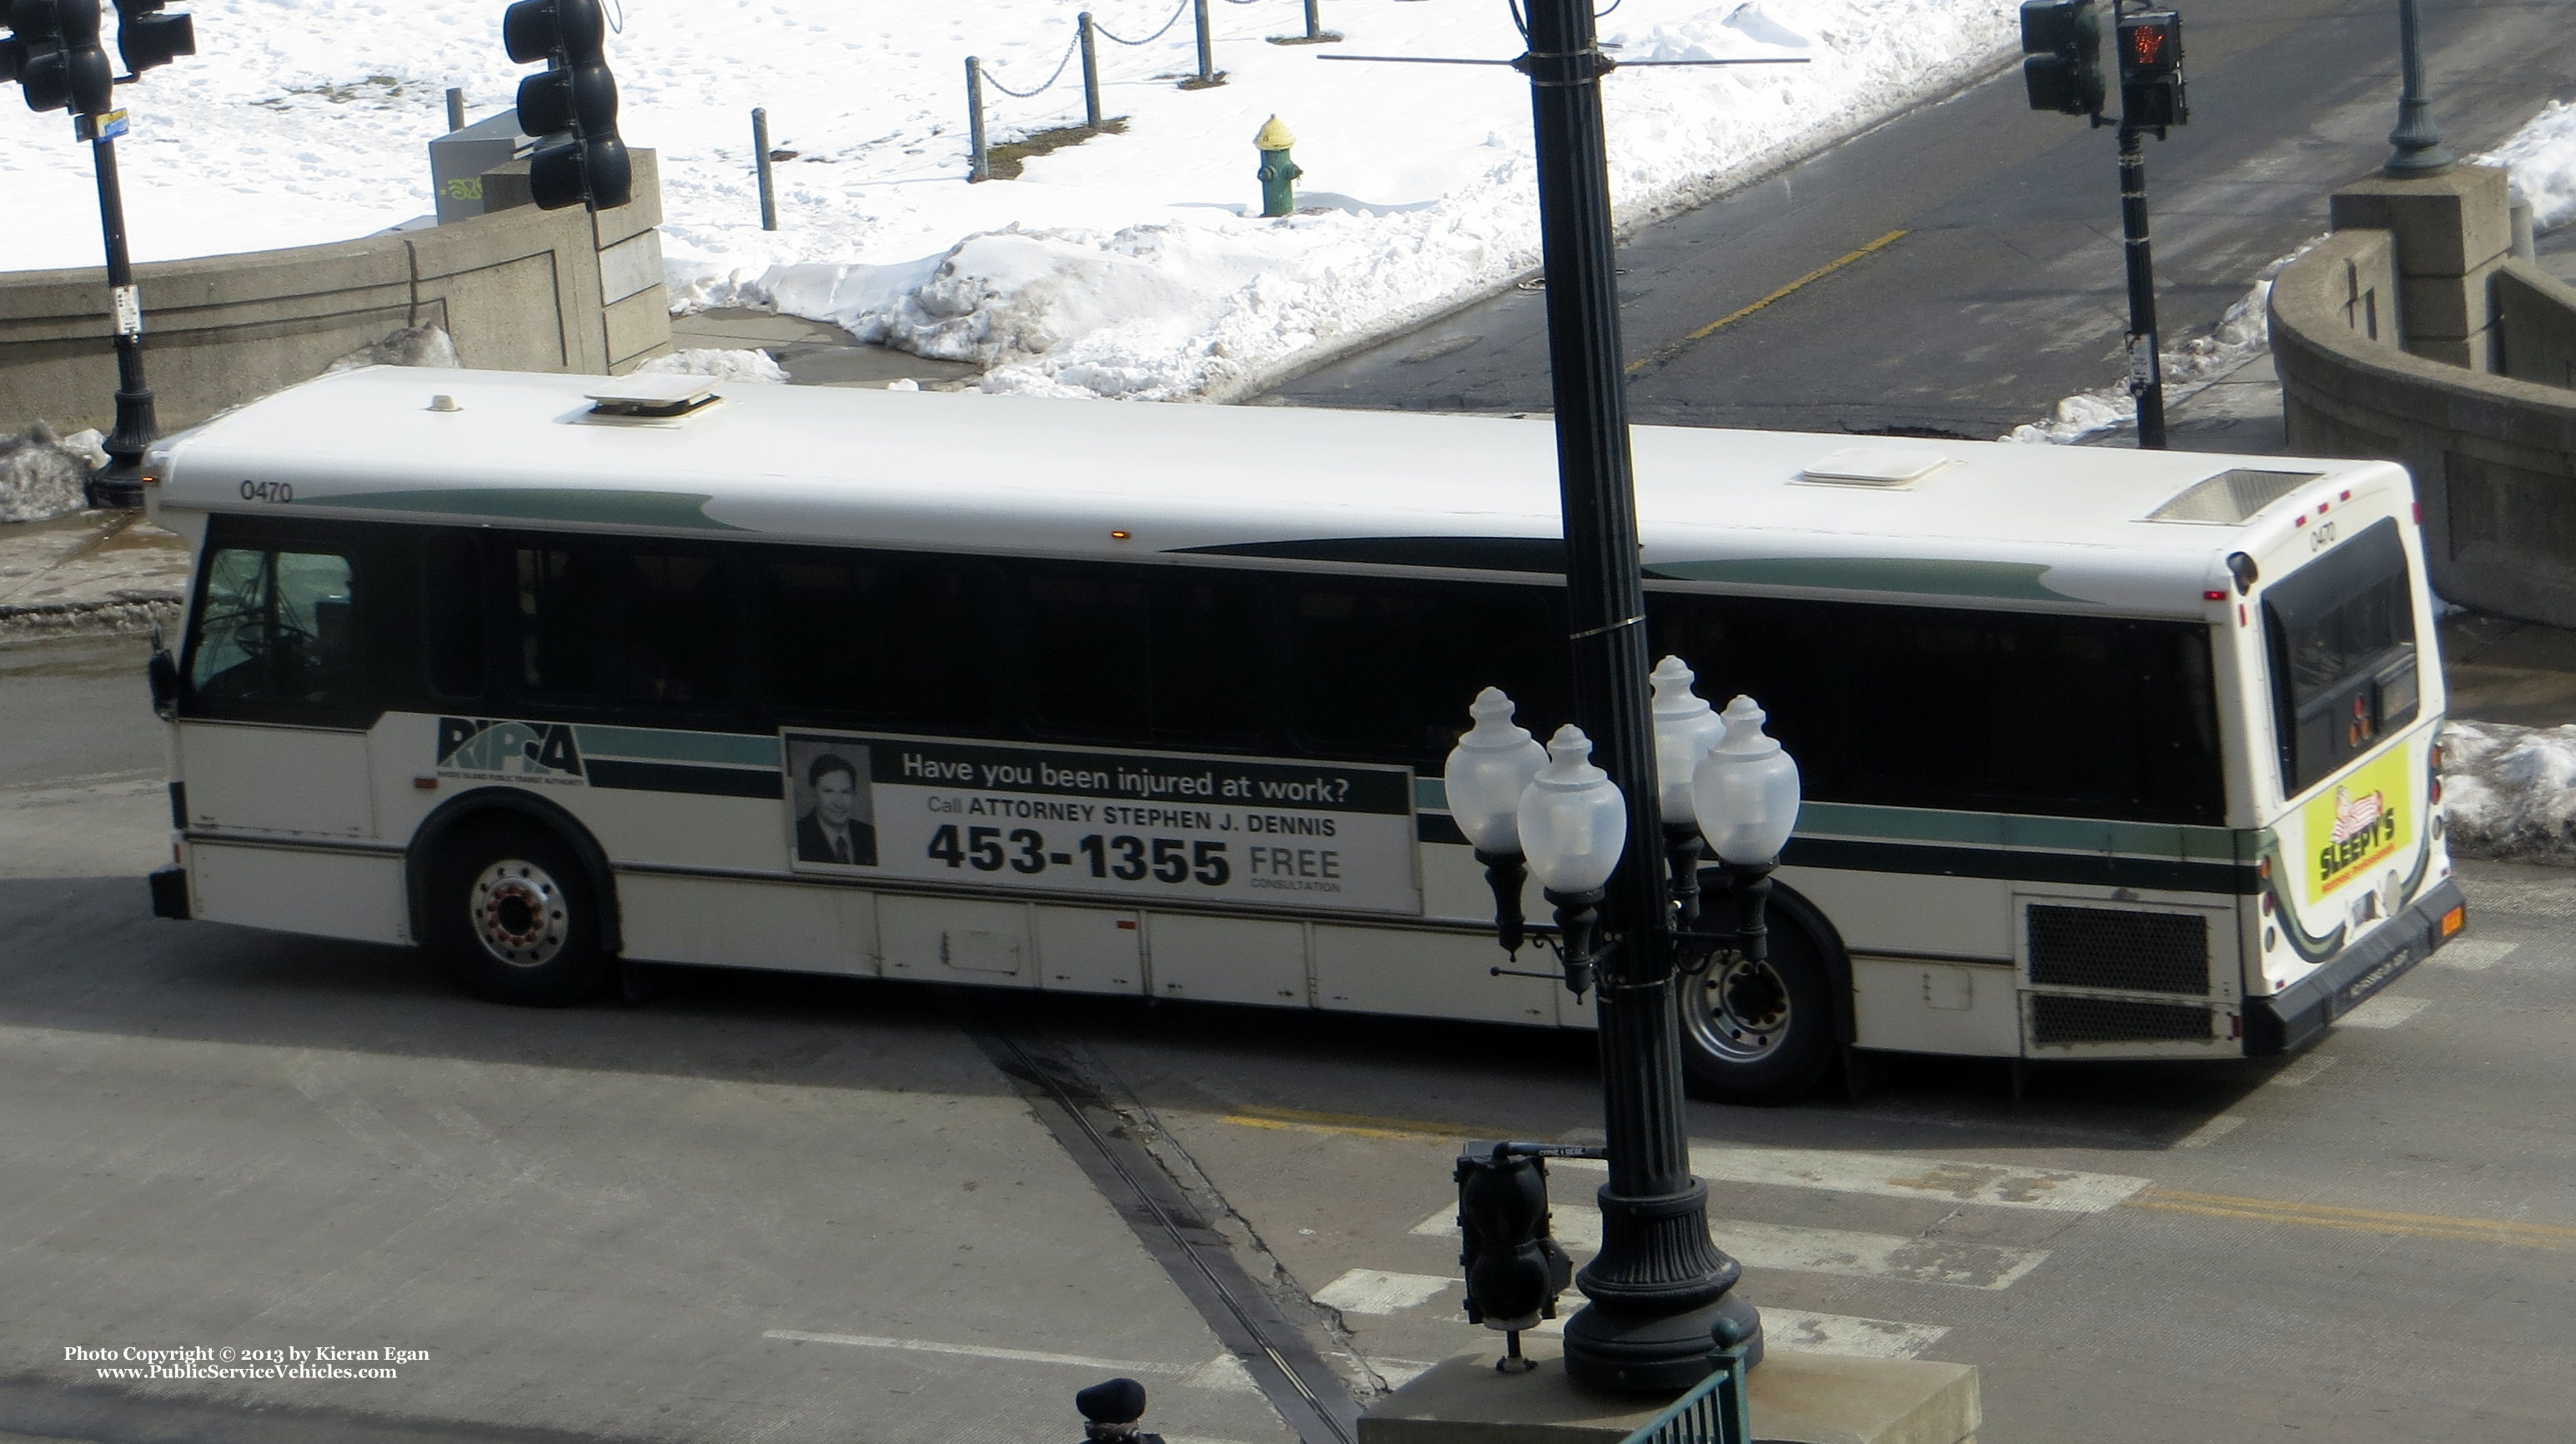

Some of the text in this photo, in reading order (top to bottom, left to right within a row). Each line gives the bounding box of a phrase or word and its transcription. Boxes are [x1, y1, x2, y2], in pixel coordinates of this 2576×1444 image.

[239, 479, 294, 504] 0470
[2309, 521, 2337, 552] 0470
[903, 753, 1350, 803] Have you been injured at work?
[927, 795, 1338, 837] Call ATTORNEY STEPHEN J. DENNIS
[927, 823, 1341, 886] 453-1355 FREE
[2320, 806, 2395, 881] SLEEPY'S
[1250, 877, 1343, 893] CONSULTATION
